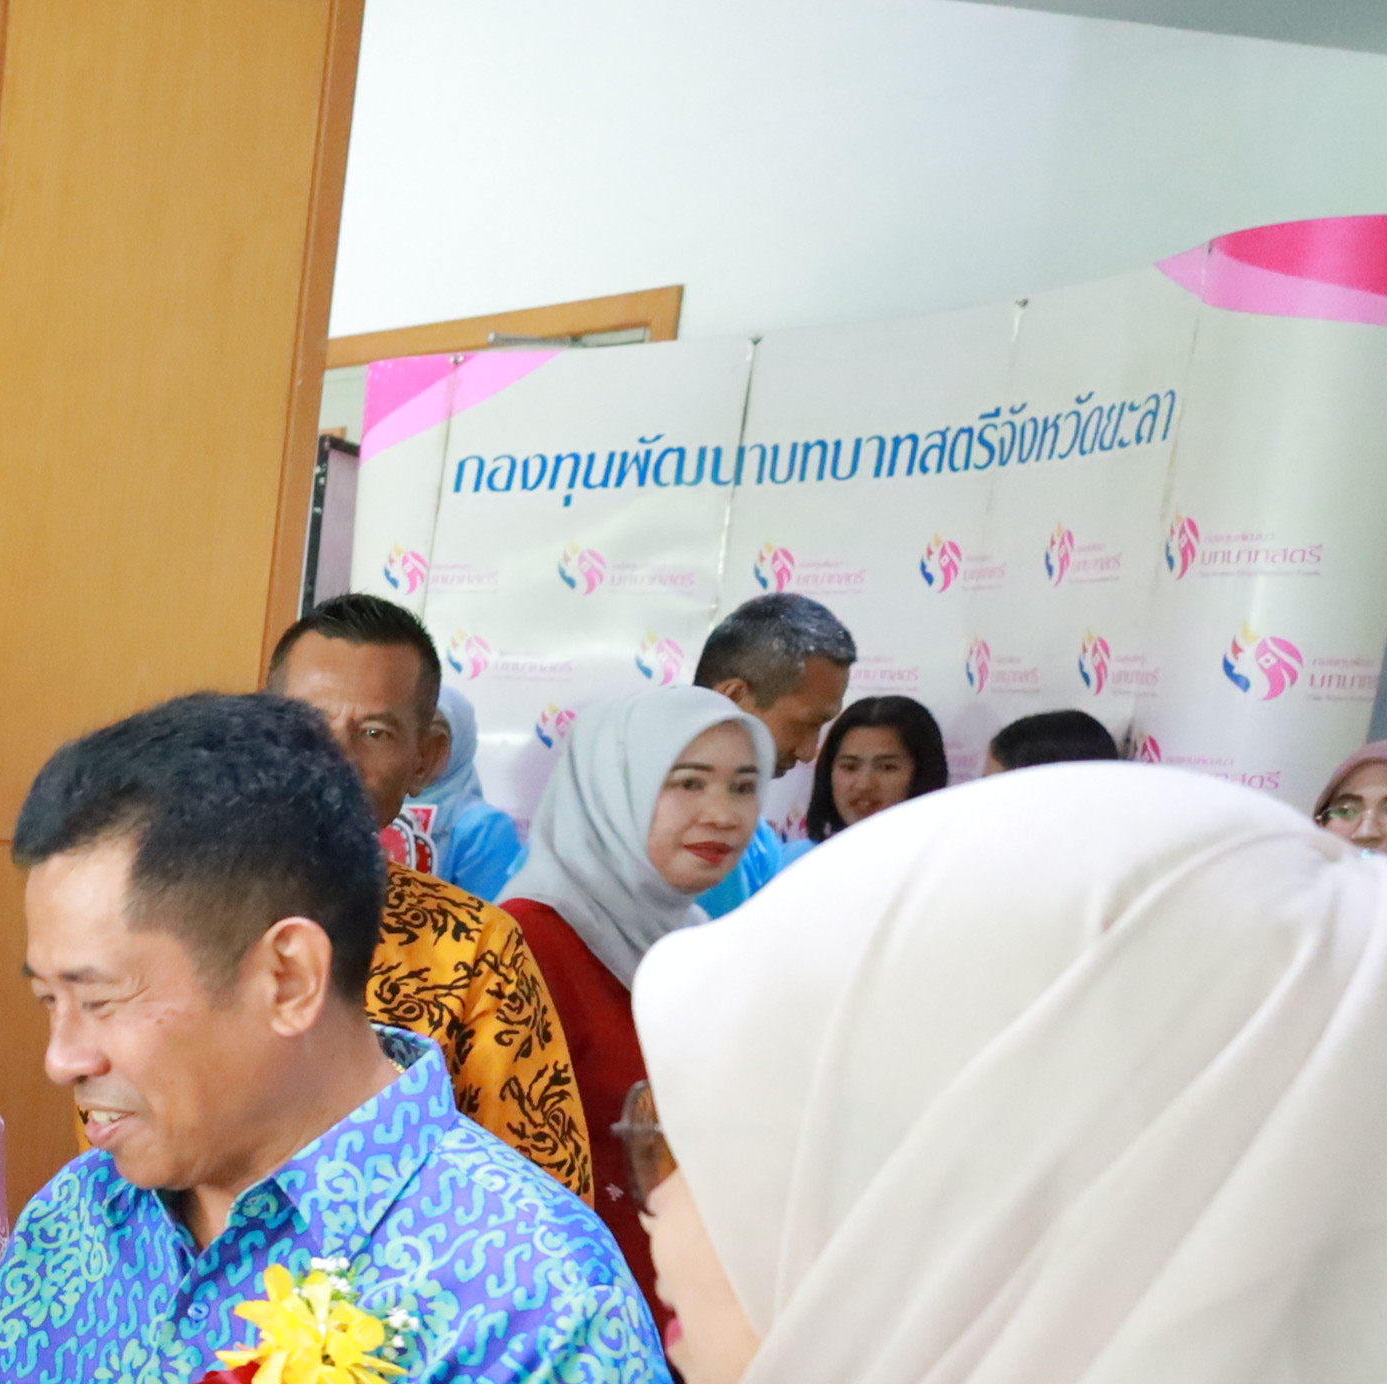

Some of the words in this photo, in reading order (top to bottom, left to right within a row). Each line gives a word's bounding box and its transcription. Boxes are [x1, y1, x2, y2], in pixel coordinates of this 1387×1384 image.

[453, 389, 1176, 507] กองทุนพัฒนาบทบาทสตรีจังหวัดยะลา
